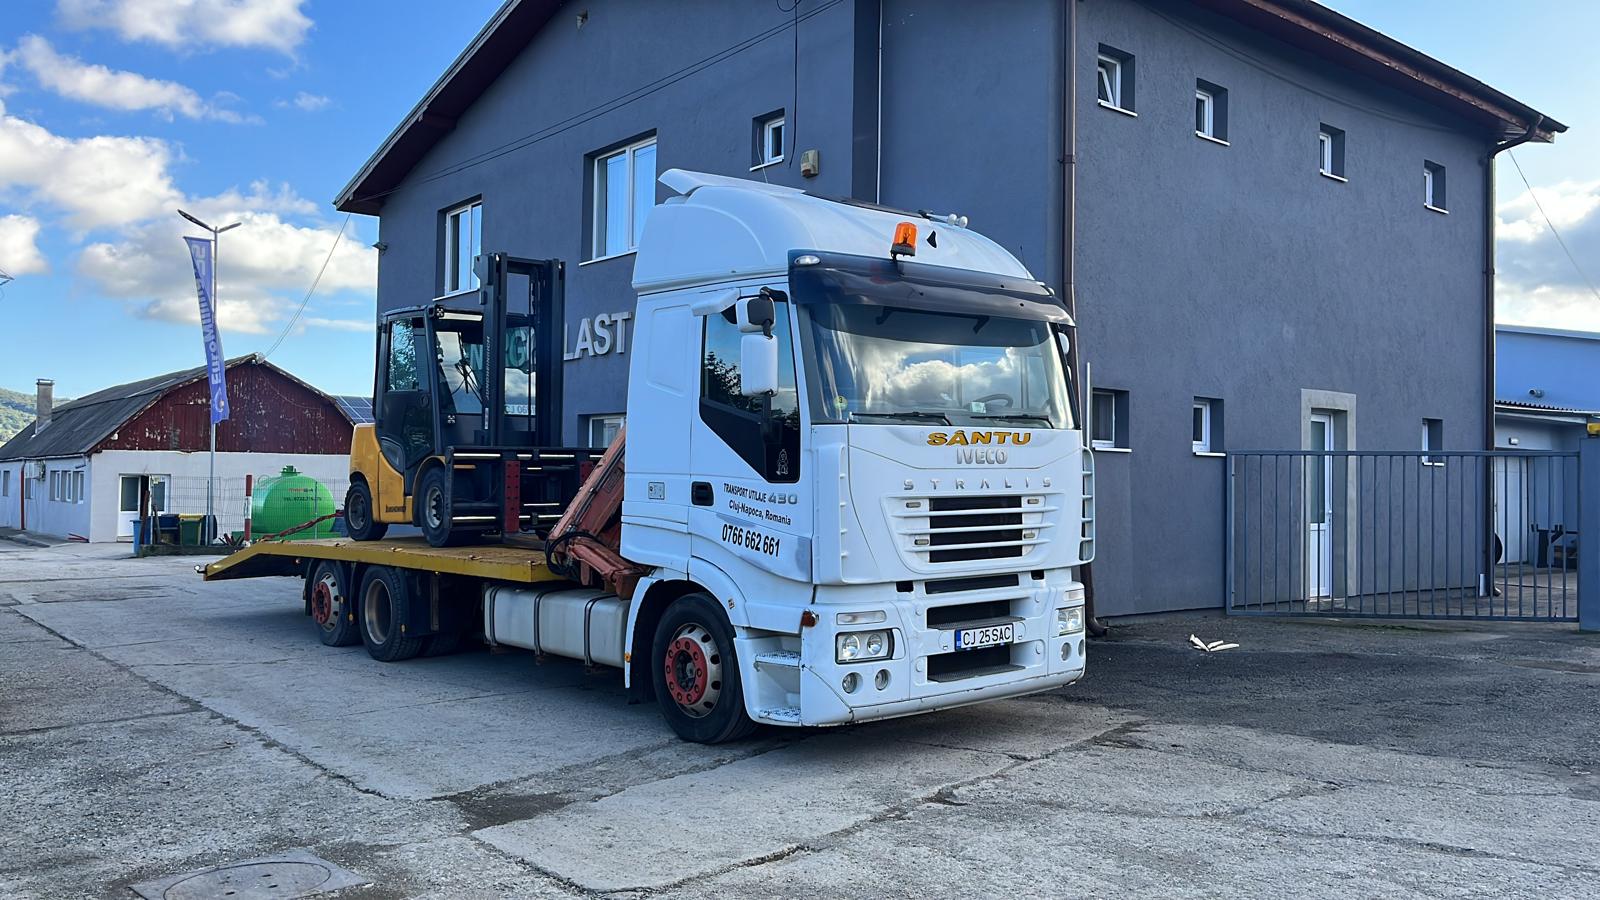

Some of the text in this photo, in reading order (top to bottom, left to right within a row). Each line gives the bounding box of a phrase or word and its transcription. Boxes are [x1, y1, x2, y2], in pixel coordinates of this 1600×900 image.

[926, 429, 1031, 446] SÂNTU
[956, 448, 1008, 465] IVECO
[903, 476, 1052, 491] STRALIS
[723, 483, 767, 503] TRANSPORT UTILAJE
[768, 492, 798, 505] 430
[729, 499, 791, 526] Cluj-Napoca, Romania
[722, 523, 780, 557] 0766 662 661
[963, 626, 1011, 646] CJ 25 SAC
